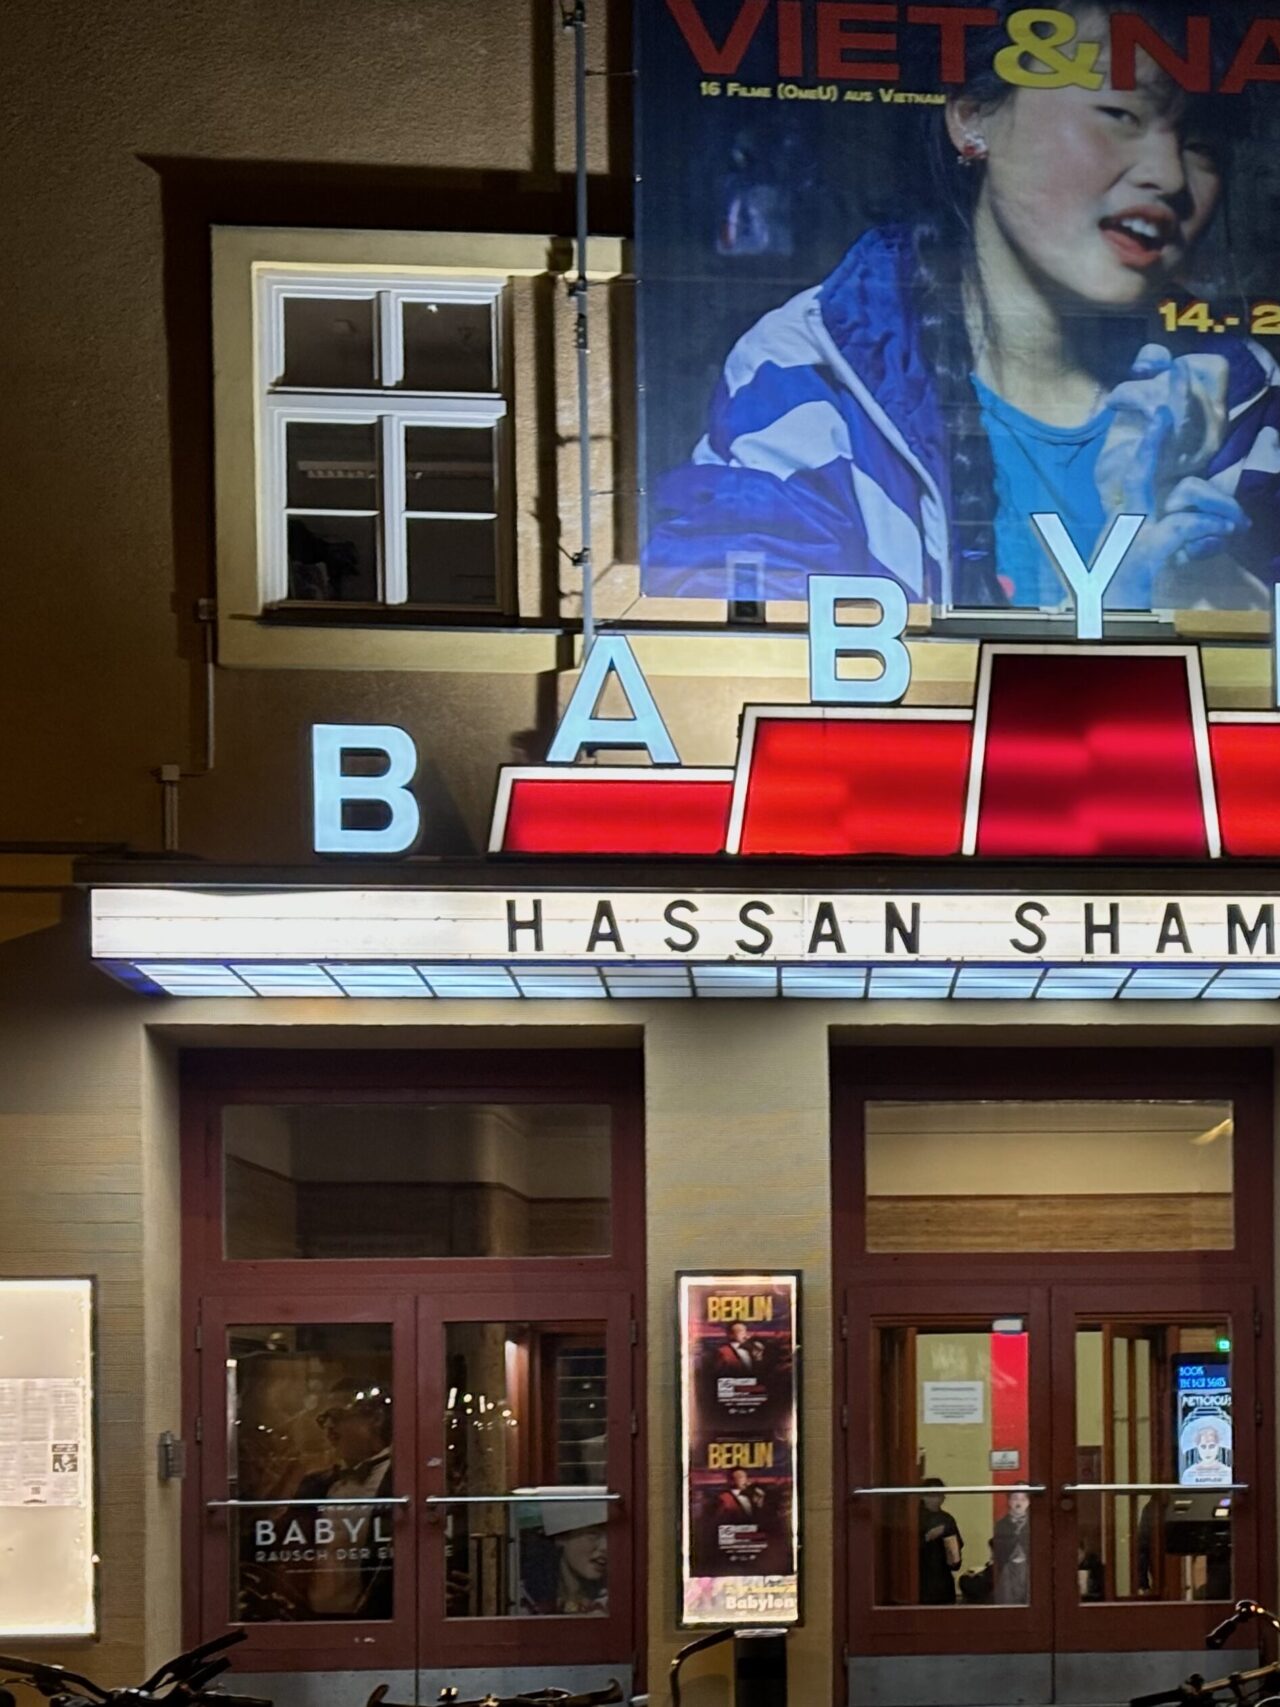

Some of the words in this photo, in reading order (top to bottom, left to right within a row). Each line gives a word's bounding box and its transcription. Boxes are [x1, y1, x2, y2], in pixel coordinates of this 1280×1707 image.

[701, 82, 721, 96] 16
[506, 899, 921, 955] HASSAN
[707, 1295, 773, 1322] BERLIN
[708, 1442, 774, 1469] BERLIN
[255, 1514, 453, 1546] BABYL
[336, 1548, 370, 1561] DER
